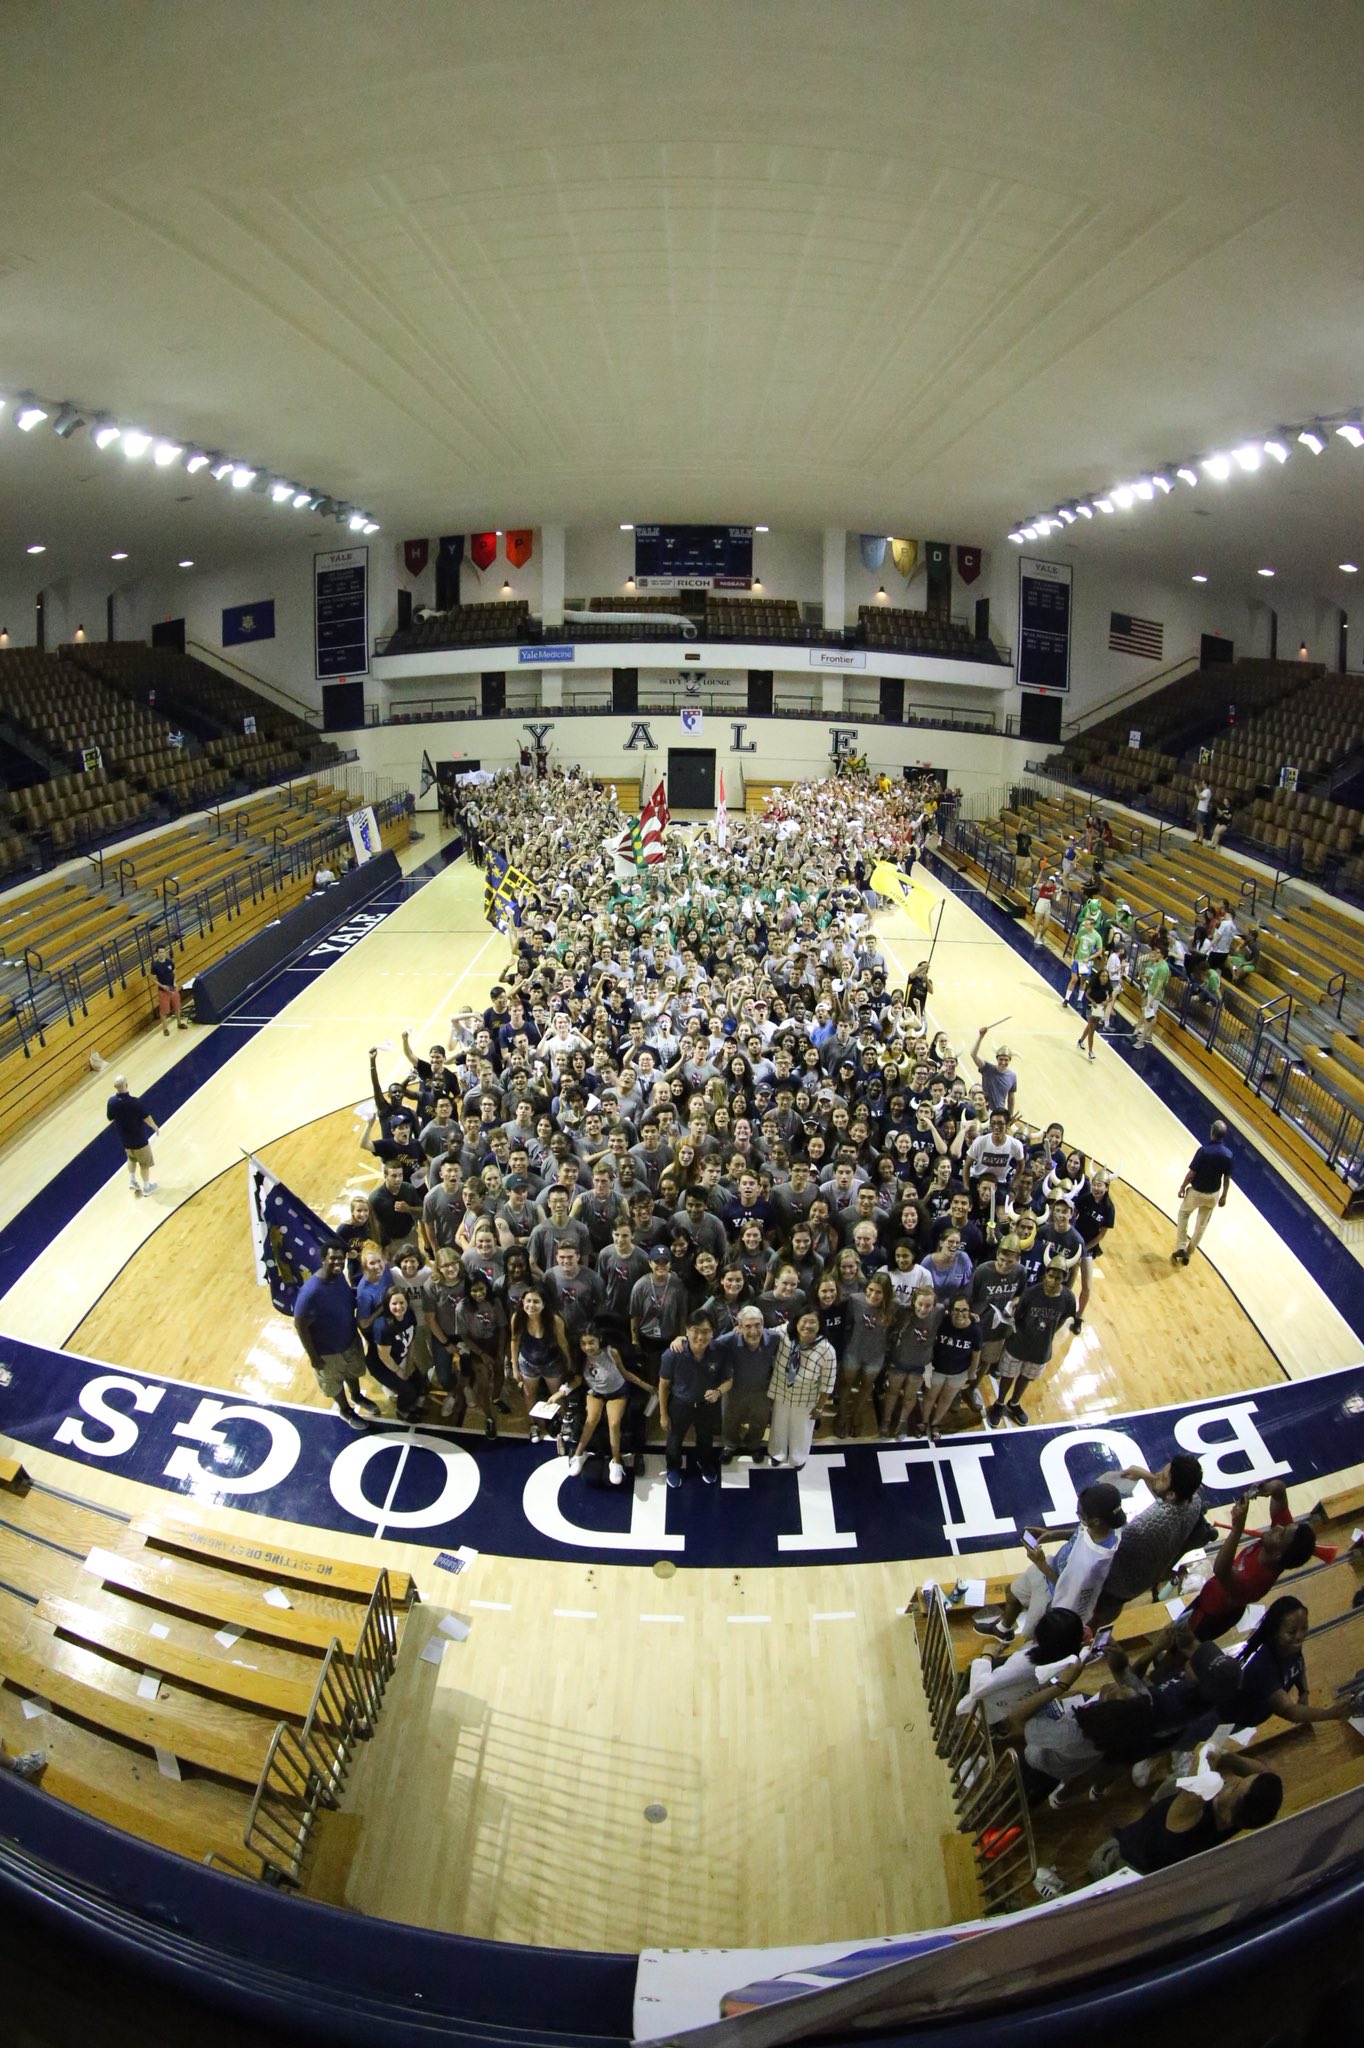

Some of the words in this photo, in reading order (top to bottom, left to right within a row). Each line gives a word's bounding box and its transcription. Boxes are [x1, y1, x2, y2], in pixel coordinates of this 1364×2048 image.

[411, 548, 421, 559] H
[448, 545, 456, 555] Y
[329, 553, 353, 563] YALE
[933, 551, 942, 562] D
[964, 555, 974, 566] C
[1035, 563, 1059, 574] YALE
[820, 653, 854, 664] Frontier
[307, 912, 388, 957] YALE
[986, 1283, 1018, 1295] YALE
[939, 1334, 971, 1349] YALE
[53, 1374, 1293, 1552] BULLDOGS
